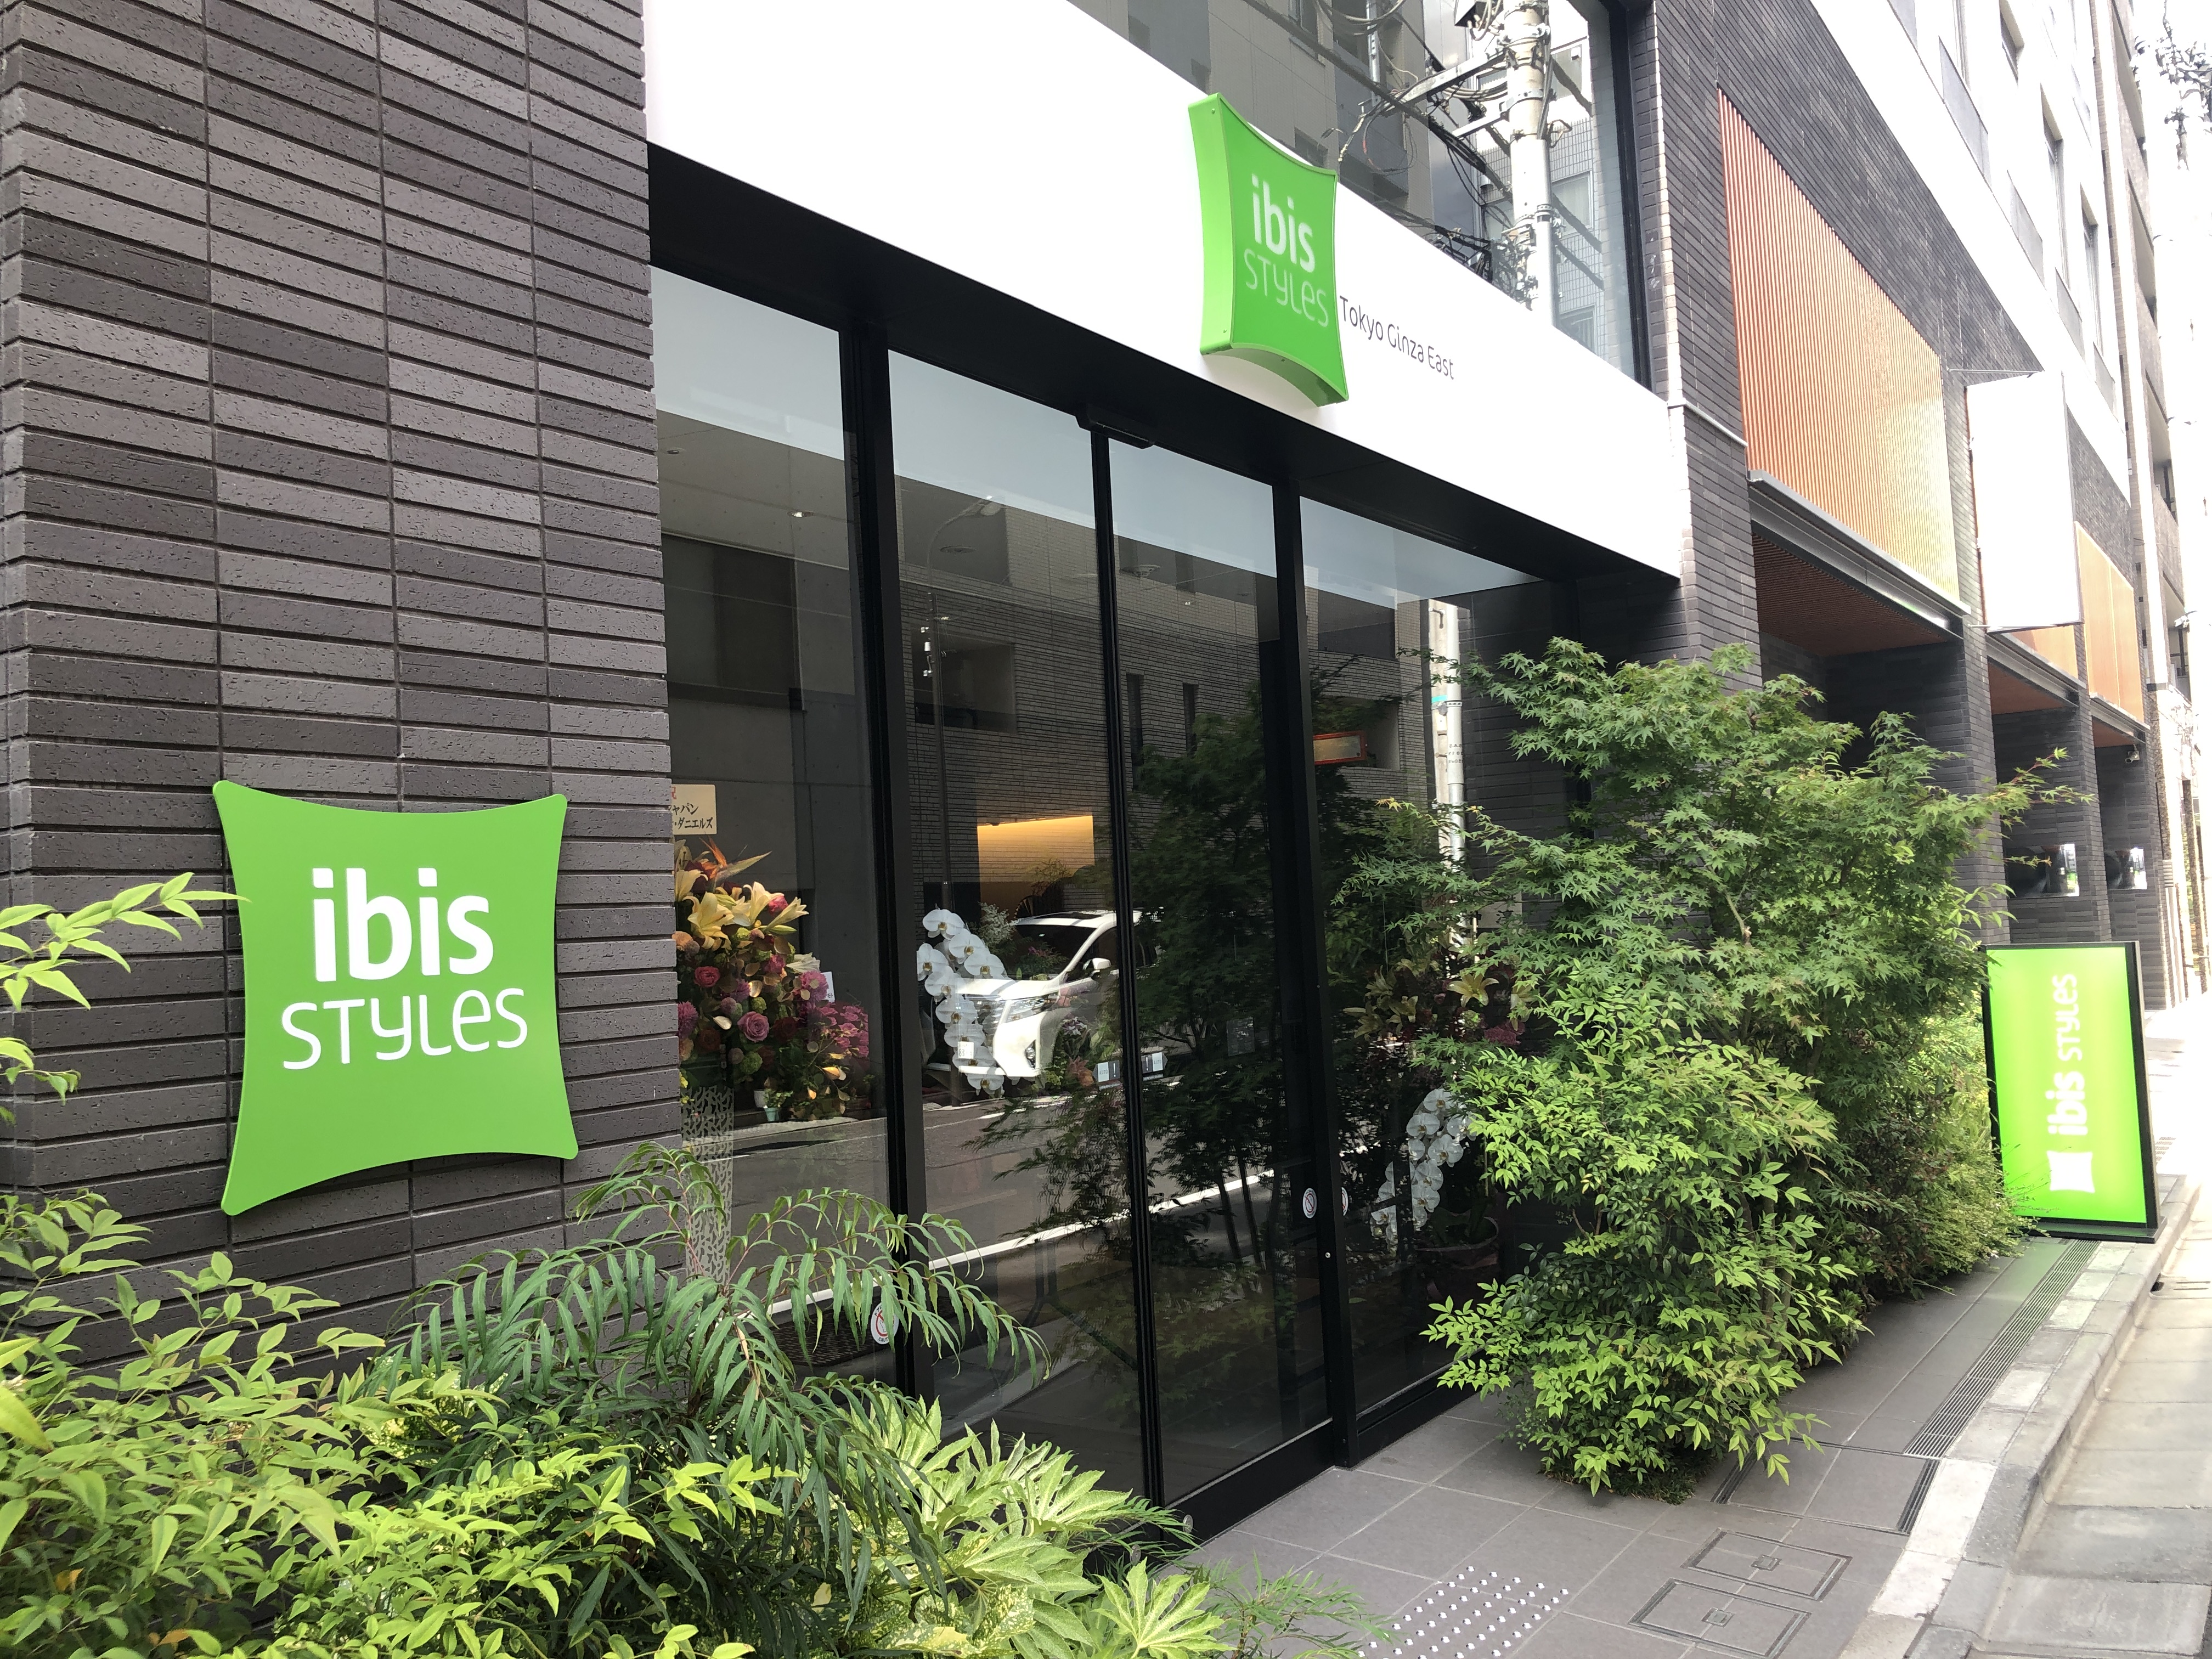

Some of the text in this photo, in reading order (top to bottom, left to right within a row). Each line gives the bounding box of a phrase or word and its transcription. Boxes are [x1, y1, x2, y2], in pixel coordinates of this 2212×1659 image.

[1251, 174, 1316, 273] ibis
[1339, 295, 1454, 380] Tokyo Ginza East
[672, 803, 699, 815] ャパン
[312, 867, 494, 982] ibis
[2045, 1071, 2089, 1136] ibis
